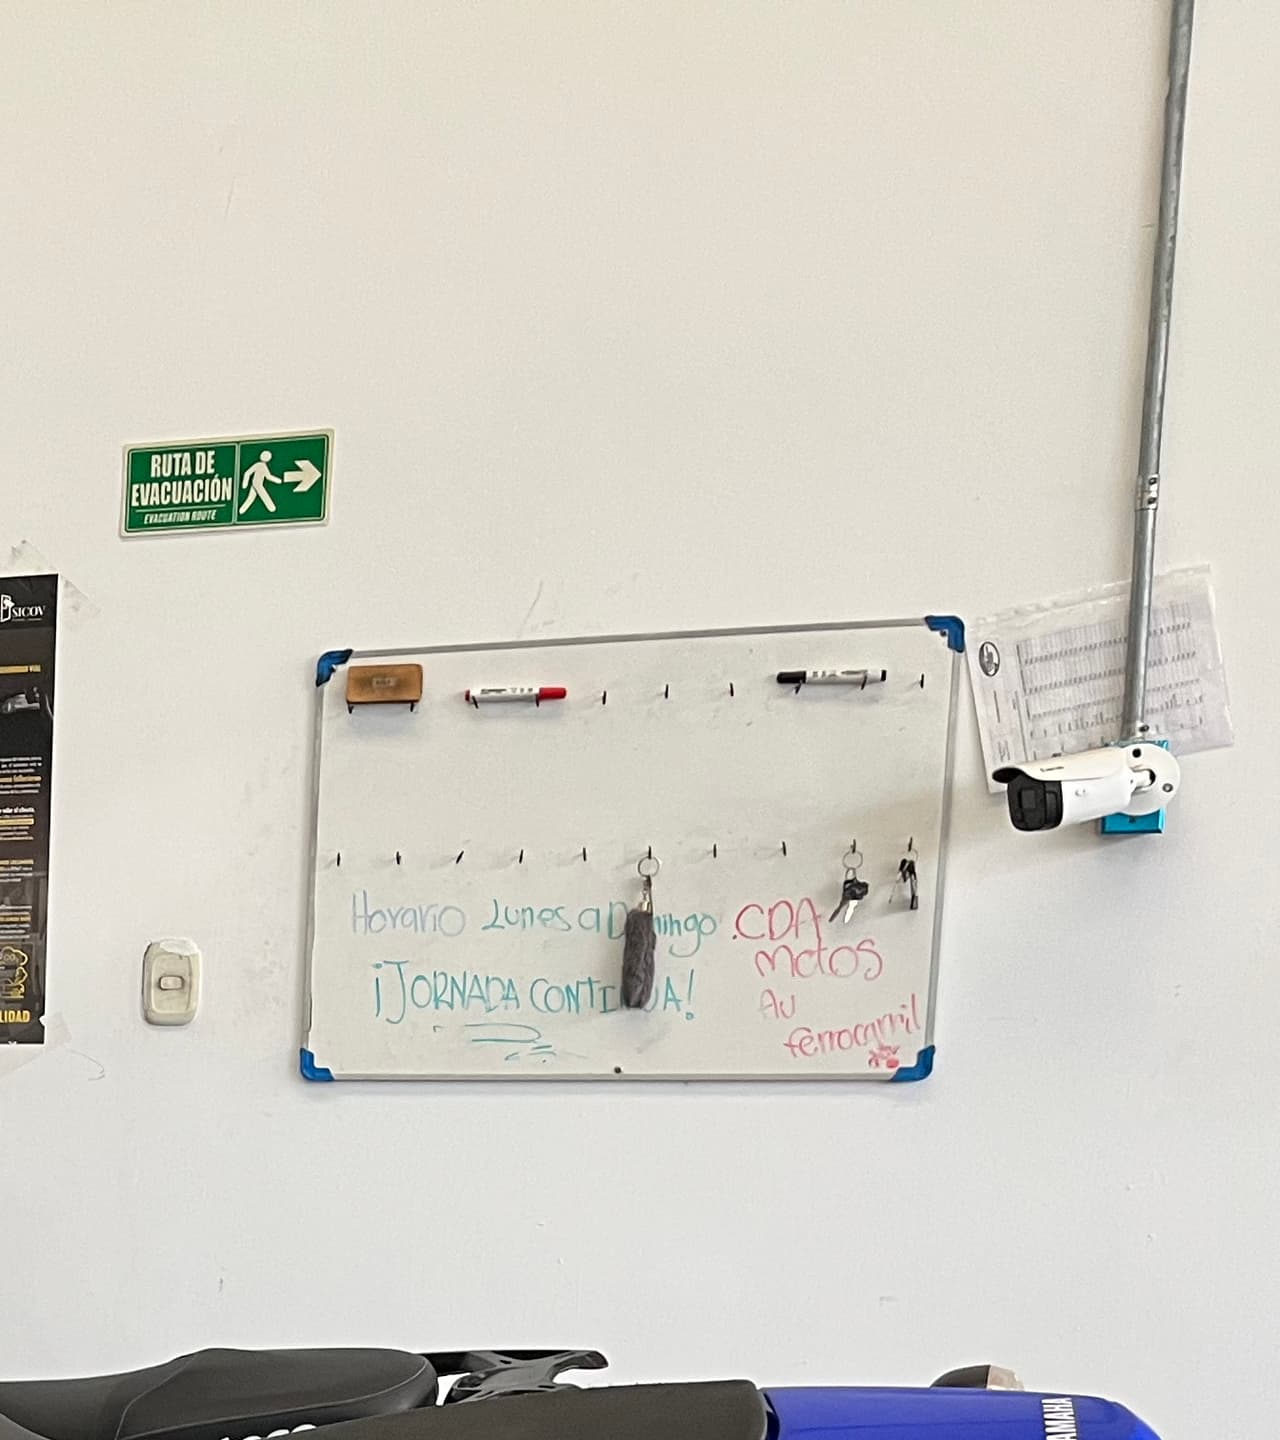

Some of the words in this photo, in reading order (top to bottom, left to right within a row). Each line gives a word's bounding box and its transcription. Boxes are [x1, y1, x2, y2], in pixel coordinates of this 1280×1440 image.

[150, 452, 191, 478] RUTA
[195, 450, 216, 475] DE
[131, 473, 233, 507] EVACUACIÓN
[144, 511, 190, 525] EVACUATION
[191, 509, 217, 521] ROUTE
[352, 890, 466, 936] Horario
[481, 899, 571, 931] Lunes
[529, 969, 697, 1020] CONTIUA!
